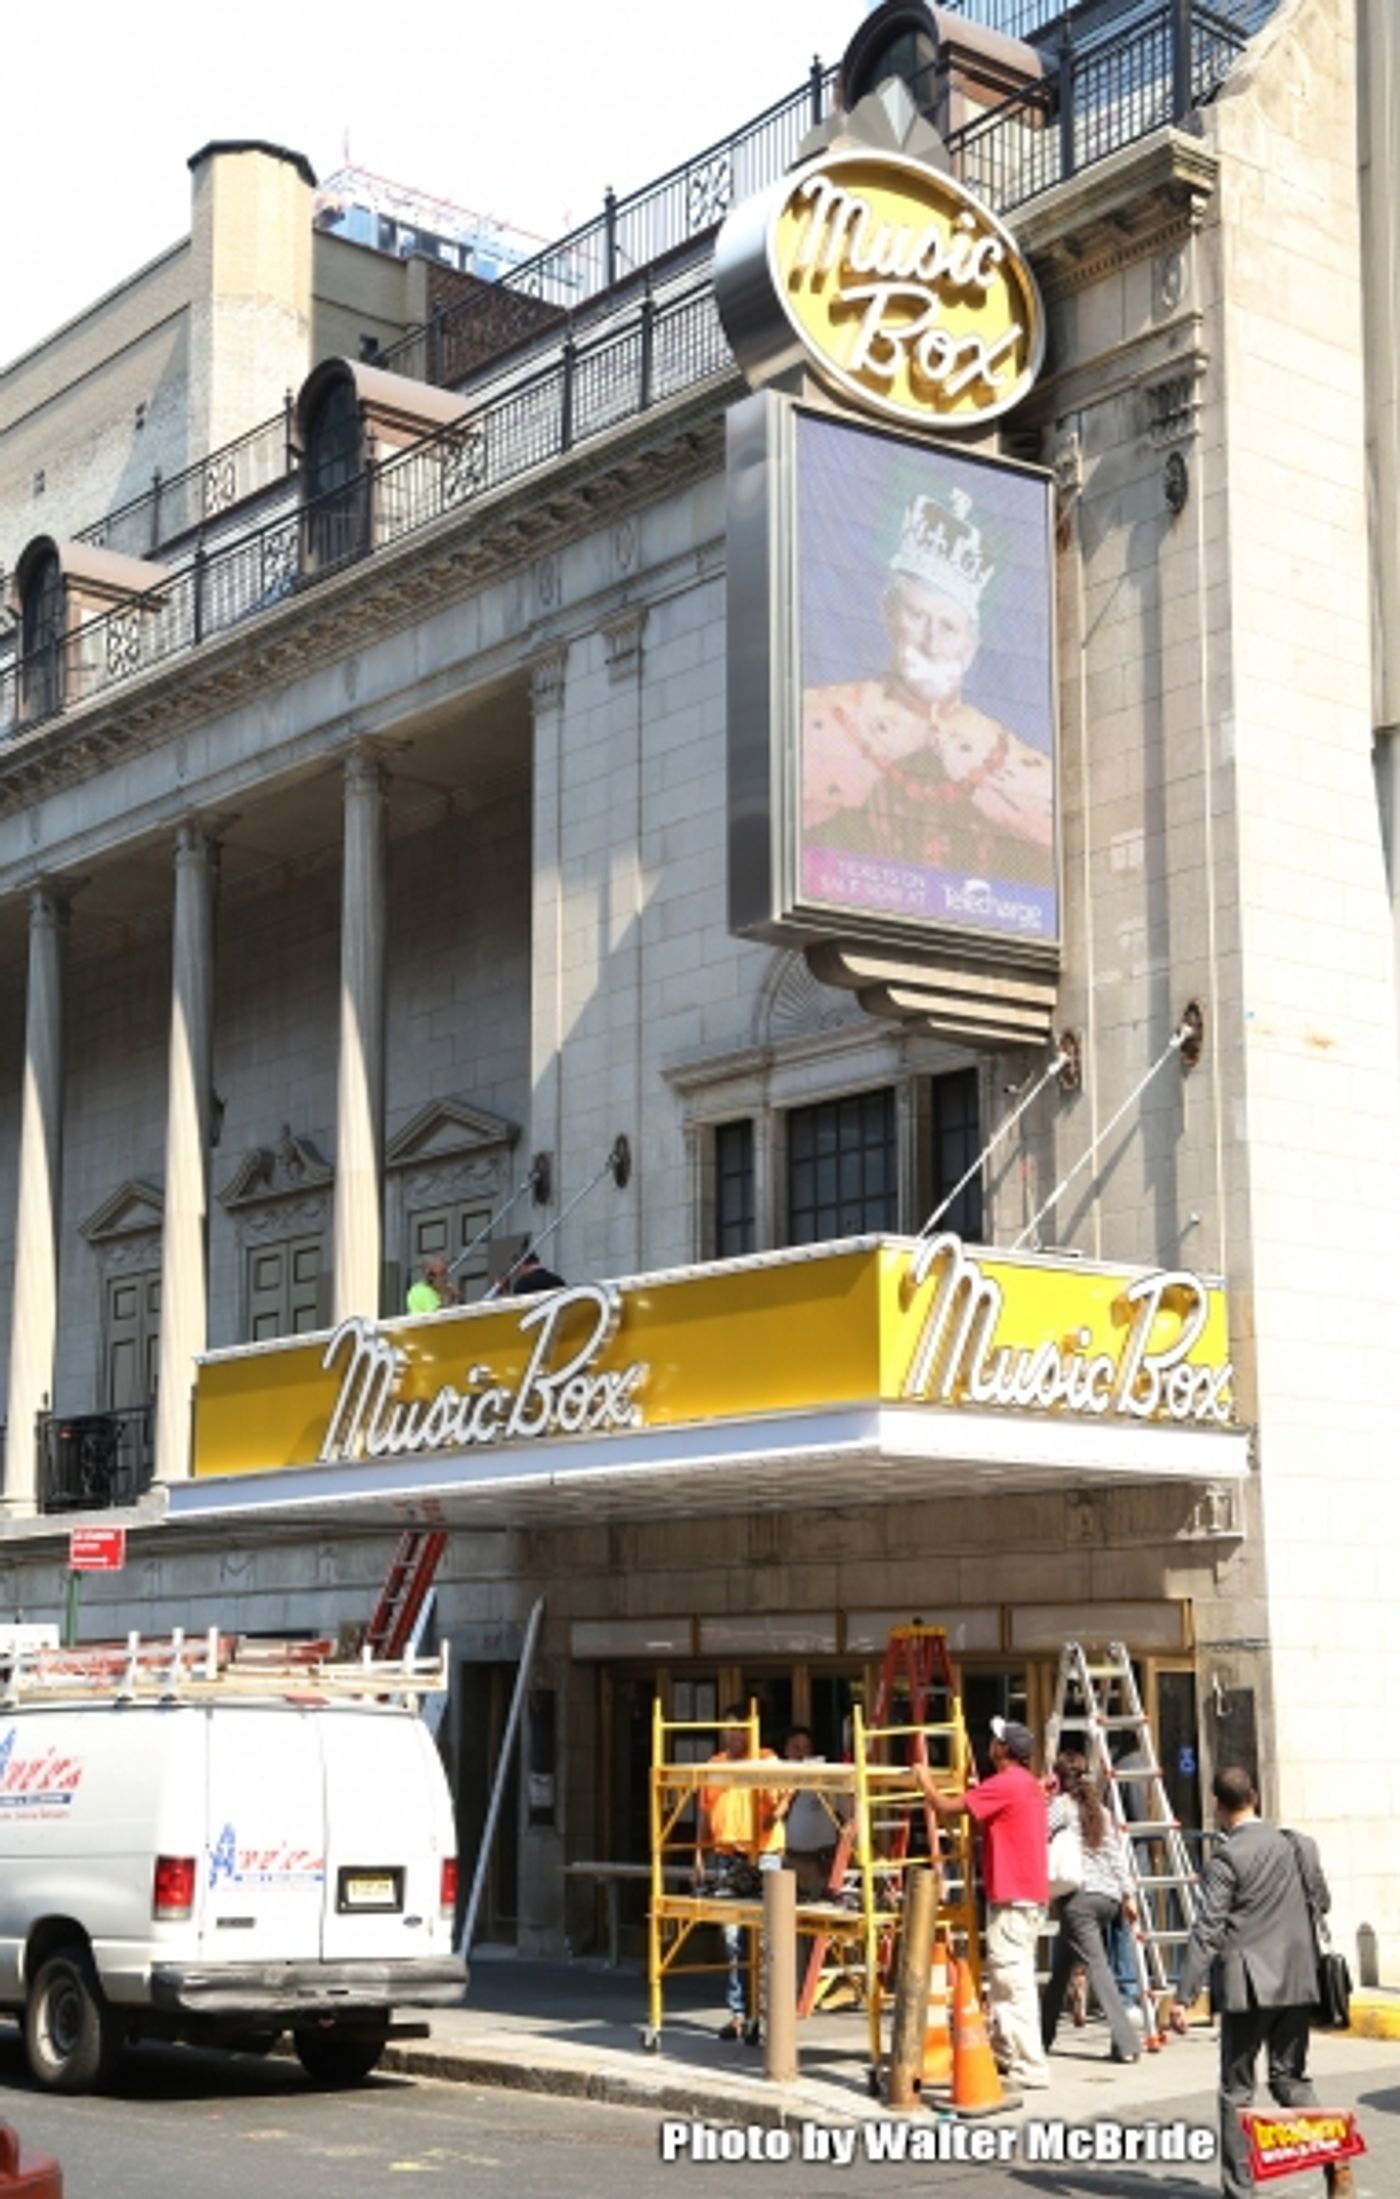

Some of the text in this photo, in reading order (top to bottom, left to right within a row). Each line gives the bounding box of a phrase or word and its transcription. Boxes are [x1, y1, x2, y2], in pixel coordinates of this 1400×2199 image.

[802, 176, 1005, 286] Music
[839, 281, 1023, 396] Box
[318, 1283, 648, 1464] Music Box
[903, 1233, 1234, 1420] Music Box
